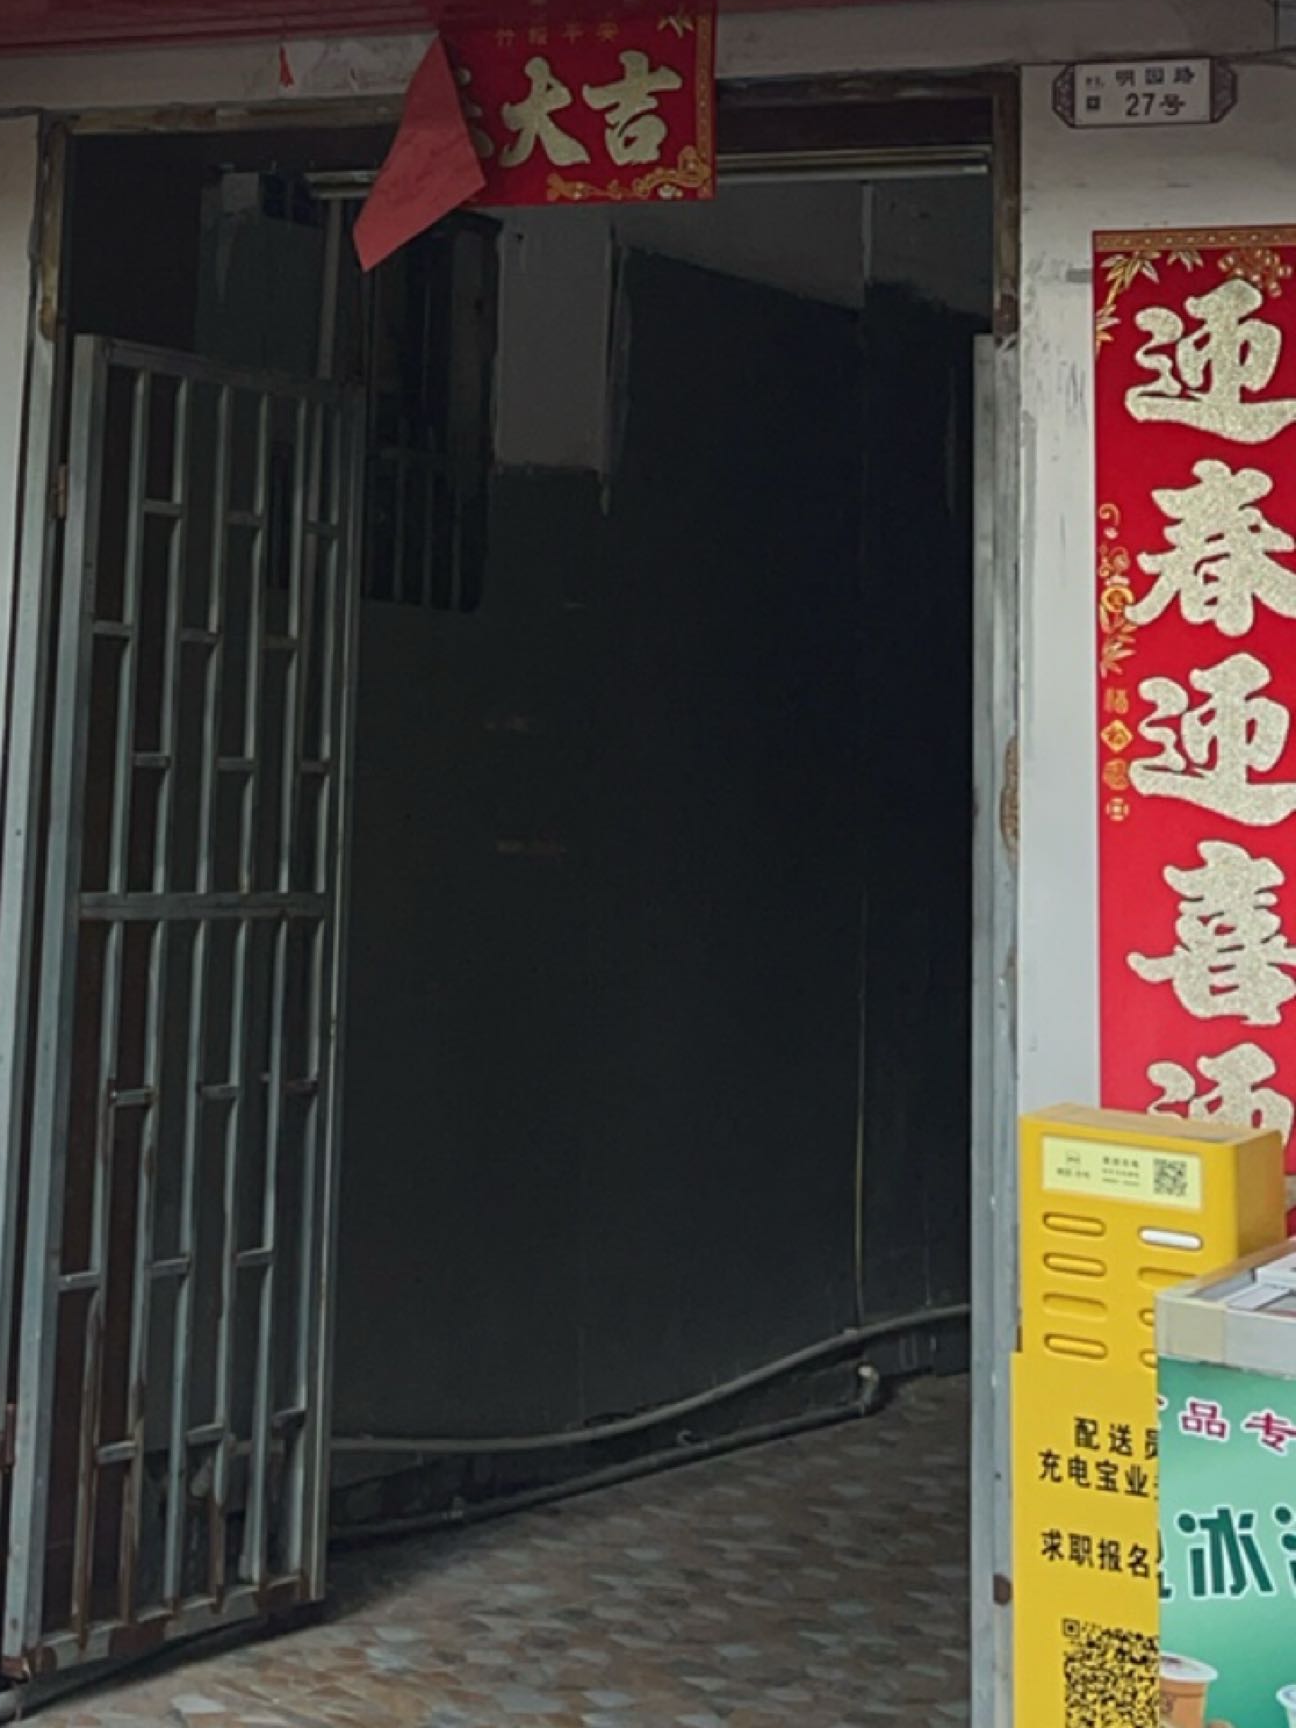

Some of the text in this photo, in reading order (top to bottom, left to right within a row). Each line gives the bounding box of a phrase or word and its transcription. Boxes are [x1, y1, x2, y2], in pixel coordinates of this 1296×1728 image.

[460, 49, 683, 166] 大吉
[1125, 92, 1186, 116] 27号
[1158, 1396, 1296, 1453] 品专
[1038, 1449, 1159, 1500] 充电宝业
[1040, 1528, 1151, 1578] 求职报名
